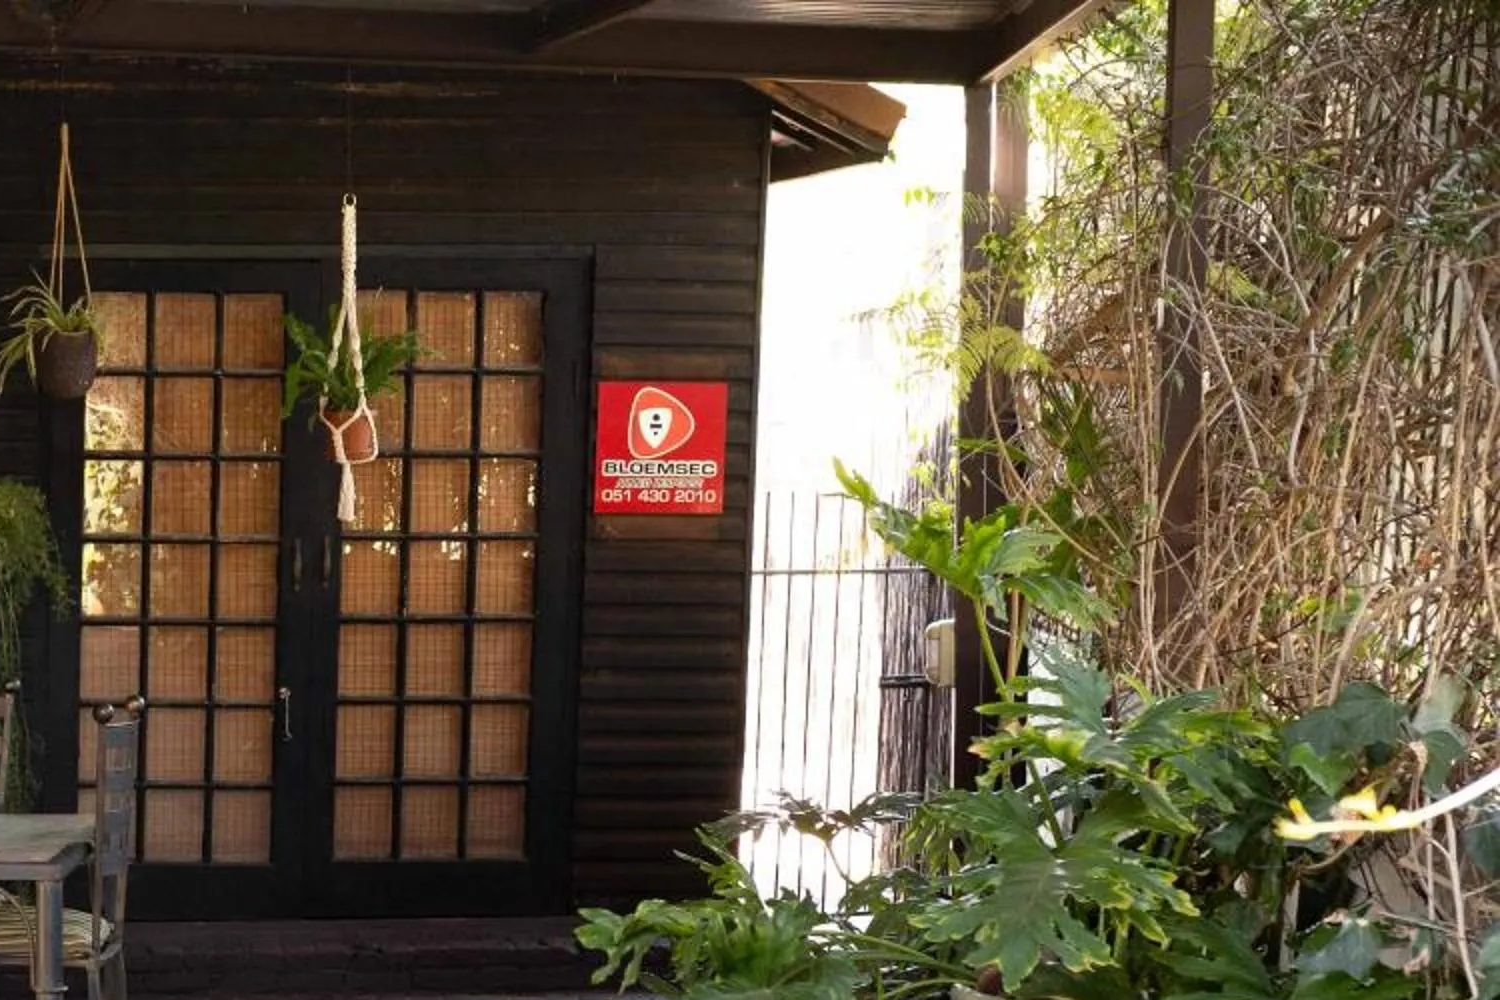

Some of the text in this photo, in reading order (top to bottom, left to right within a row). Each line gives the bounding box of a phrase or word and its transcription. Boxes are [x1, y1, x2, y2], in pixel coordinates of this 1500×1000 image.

[603, 461, 716, 475] BLOEMSEC
[601, 489, 716, 502] 051 430 2010
